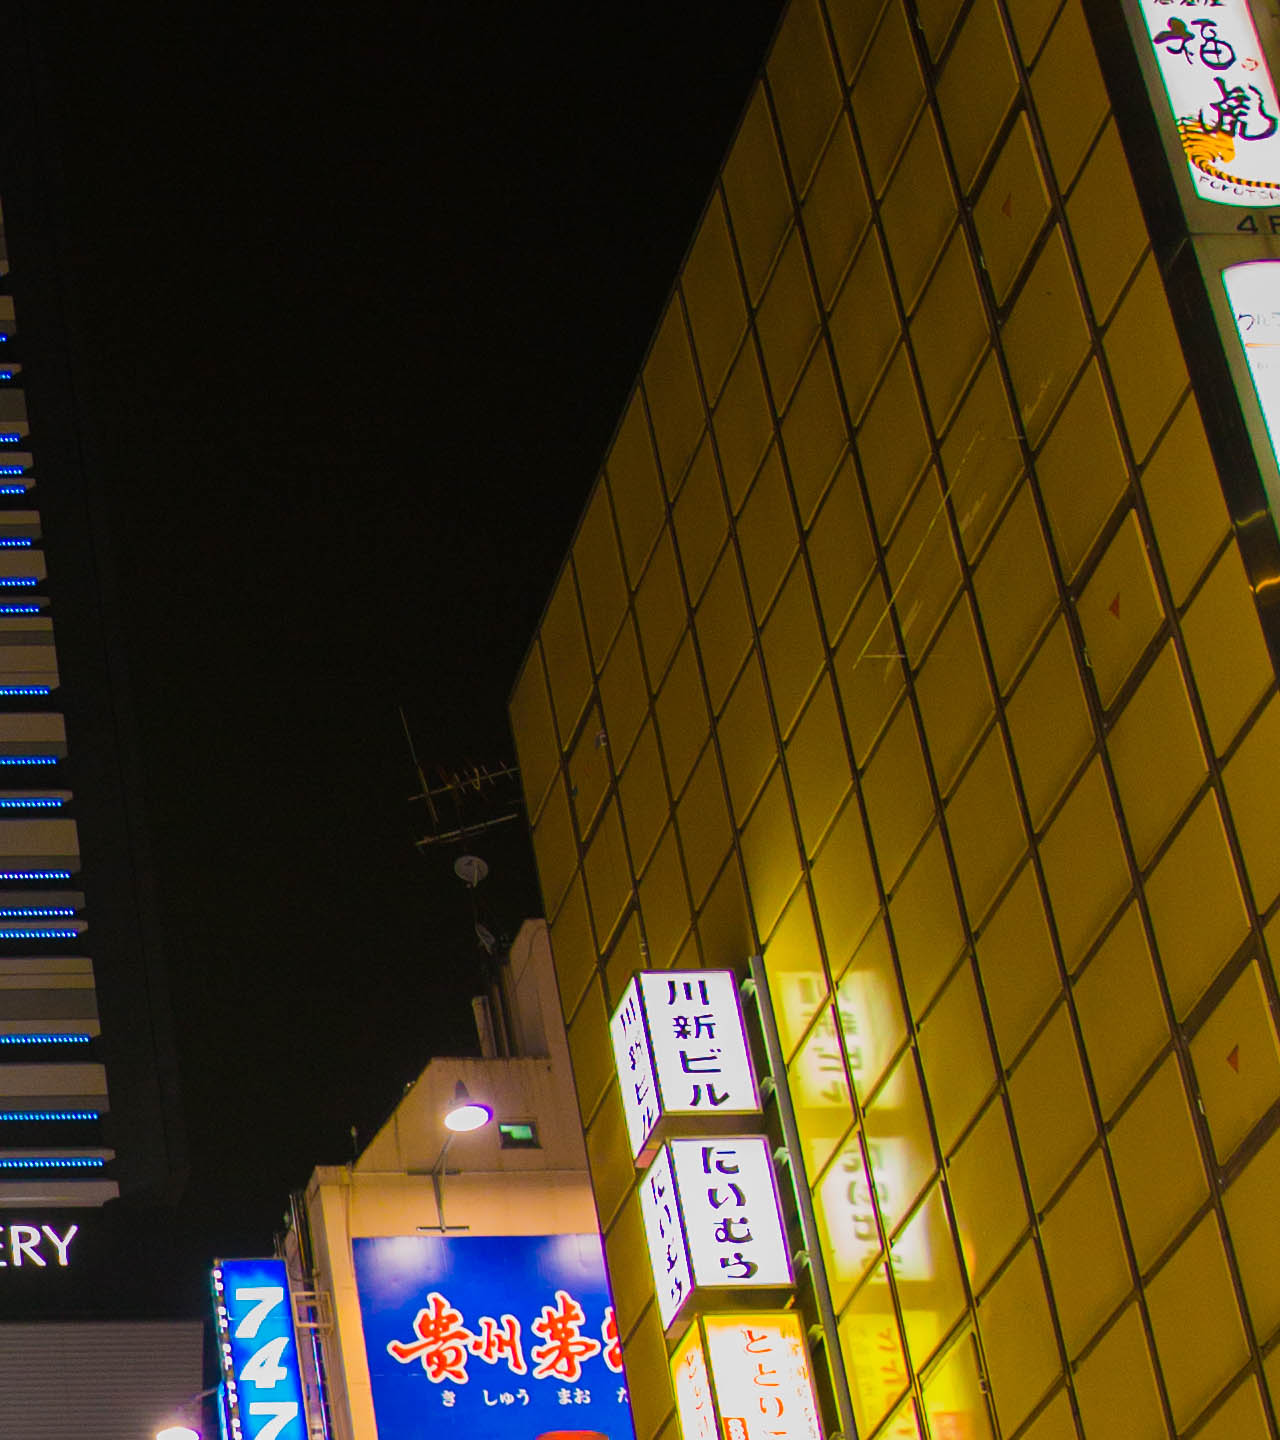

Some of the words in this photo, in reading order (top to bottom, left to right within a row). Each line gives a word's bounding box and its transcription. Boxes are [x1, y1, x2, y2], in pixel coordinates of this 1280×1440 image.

[666, 980, 730, 1107] 川新ビル
[701, 1146, 758, 1279] にいむら
[482, 1390, 530, 1408] しゅう
